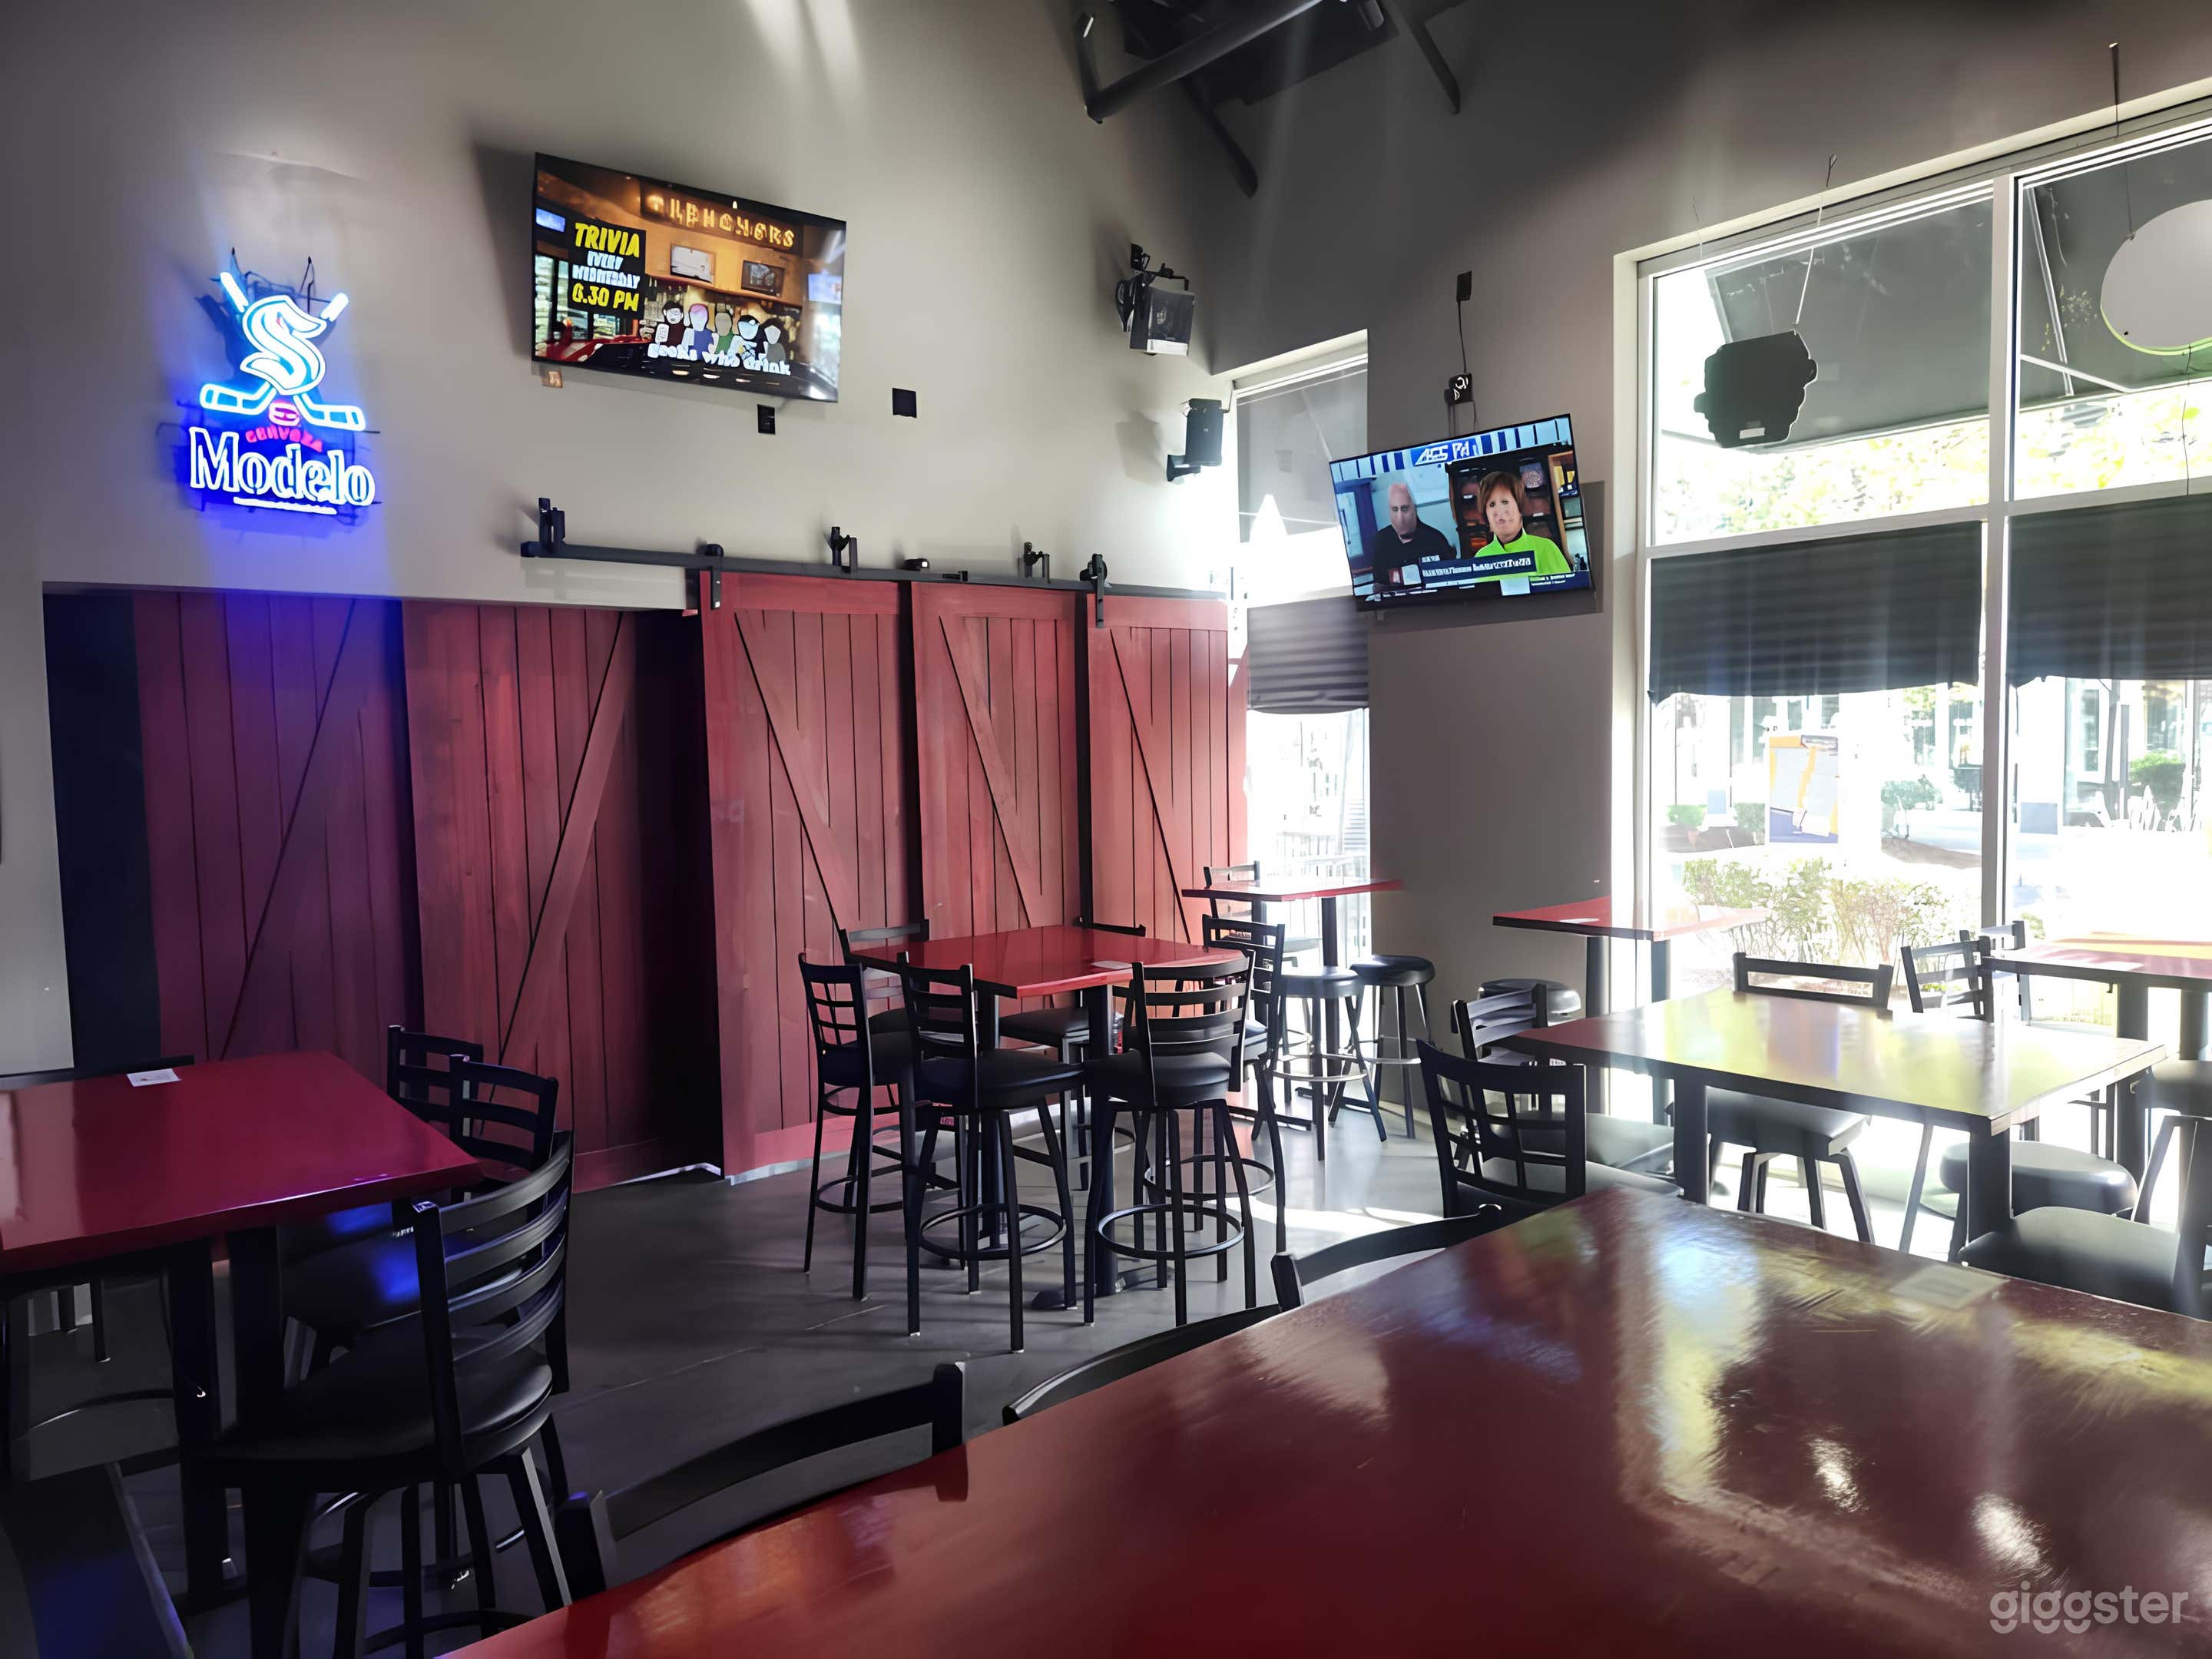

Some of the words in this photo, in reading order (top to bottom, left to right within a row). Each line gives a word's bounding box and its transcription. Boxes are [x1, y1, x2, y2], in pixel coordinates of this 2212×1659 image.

[575, 222, 640, 258] TRIVIA
[613, 290, 640, 312] PM
[189, 426, 376, 507] Modelo
